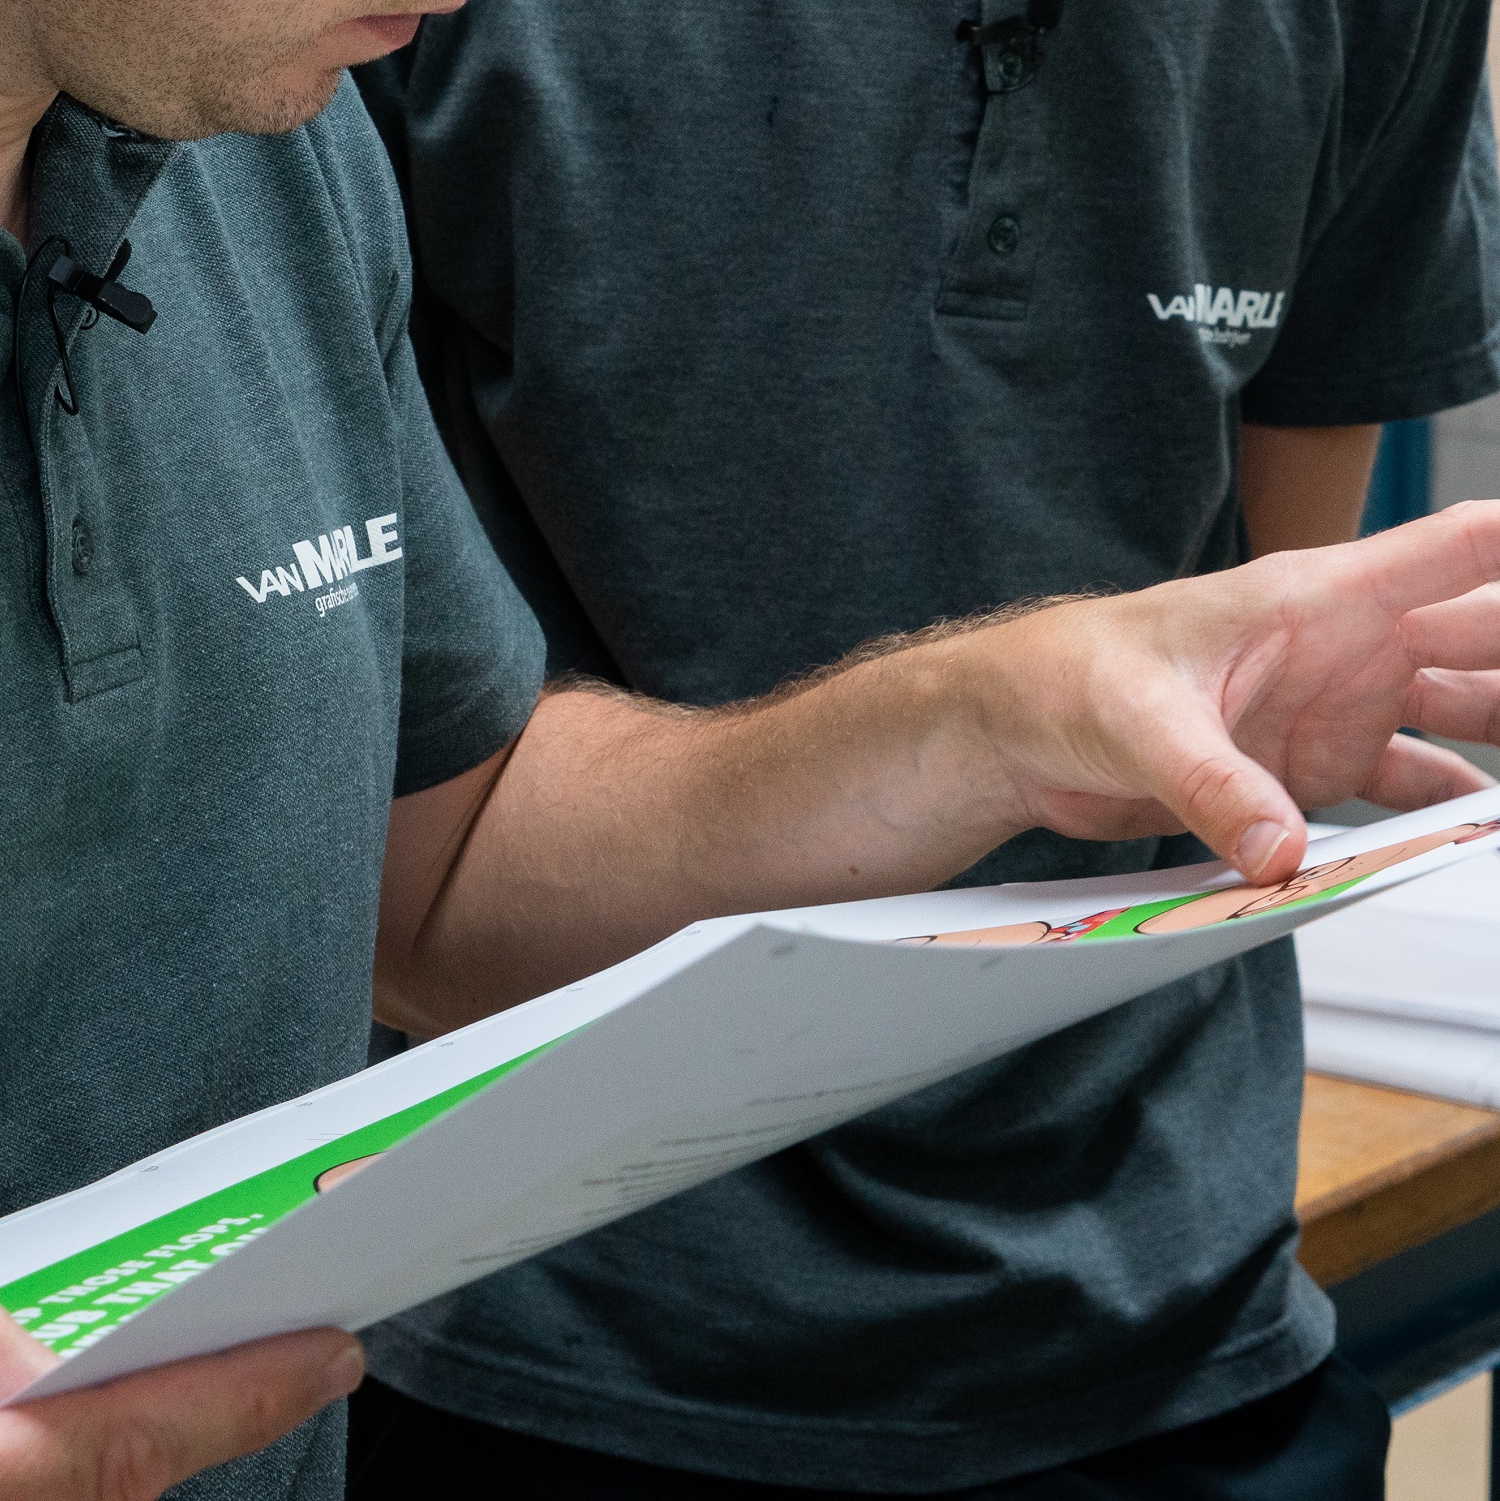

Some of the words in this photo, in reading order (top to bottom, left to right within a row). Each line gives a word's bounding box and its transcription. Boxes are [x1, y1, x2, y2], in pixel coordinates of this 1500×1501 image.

[37, 1260, 157, 1305] THOSE
[142, 1212, 265, 1259] FLOPS,
[28, 1308, 108, 1349] UB
[92, 1260, 213, 1306] THAT
